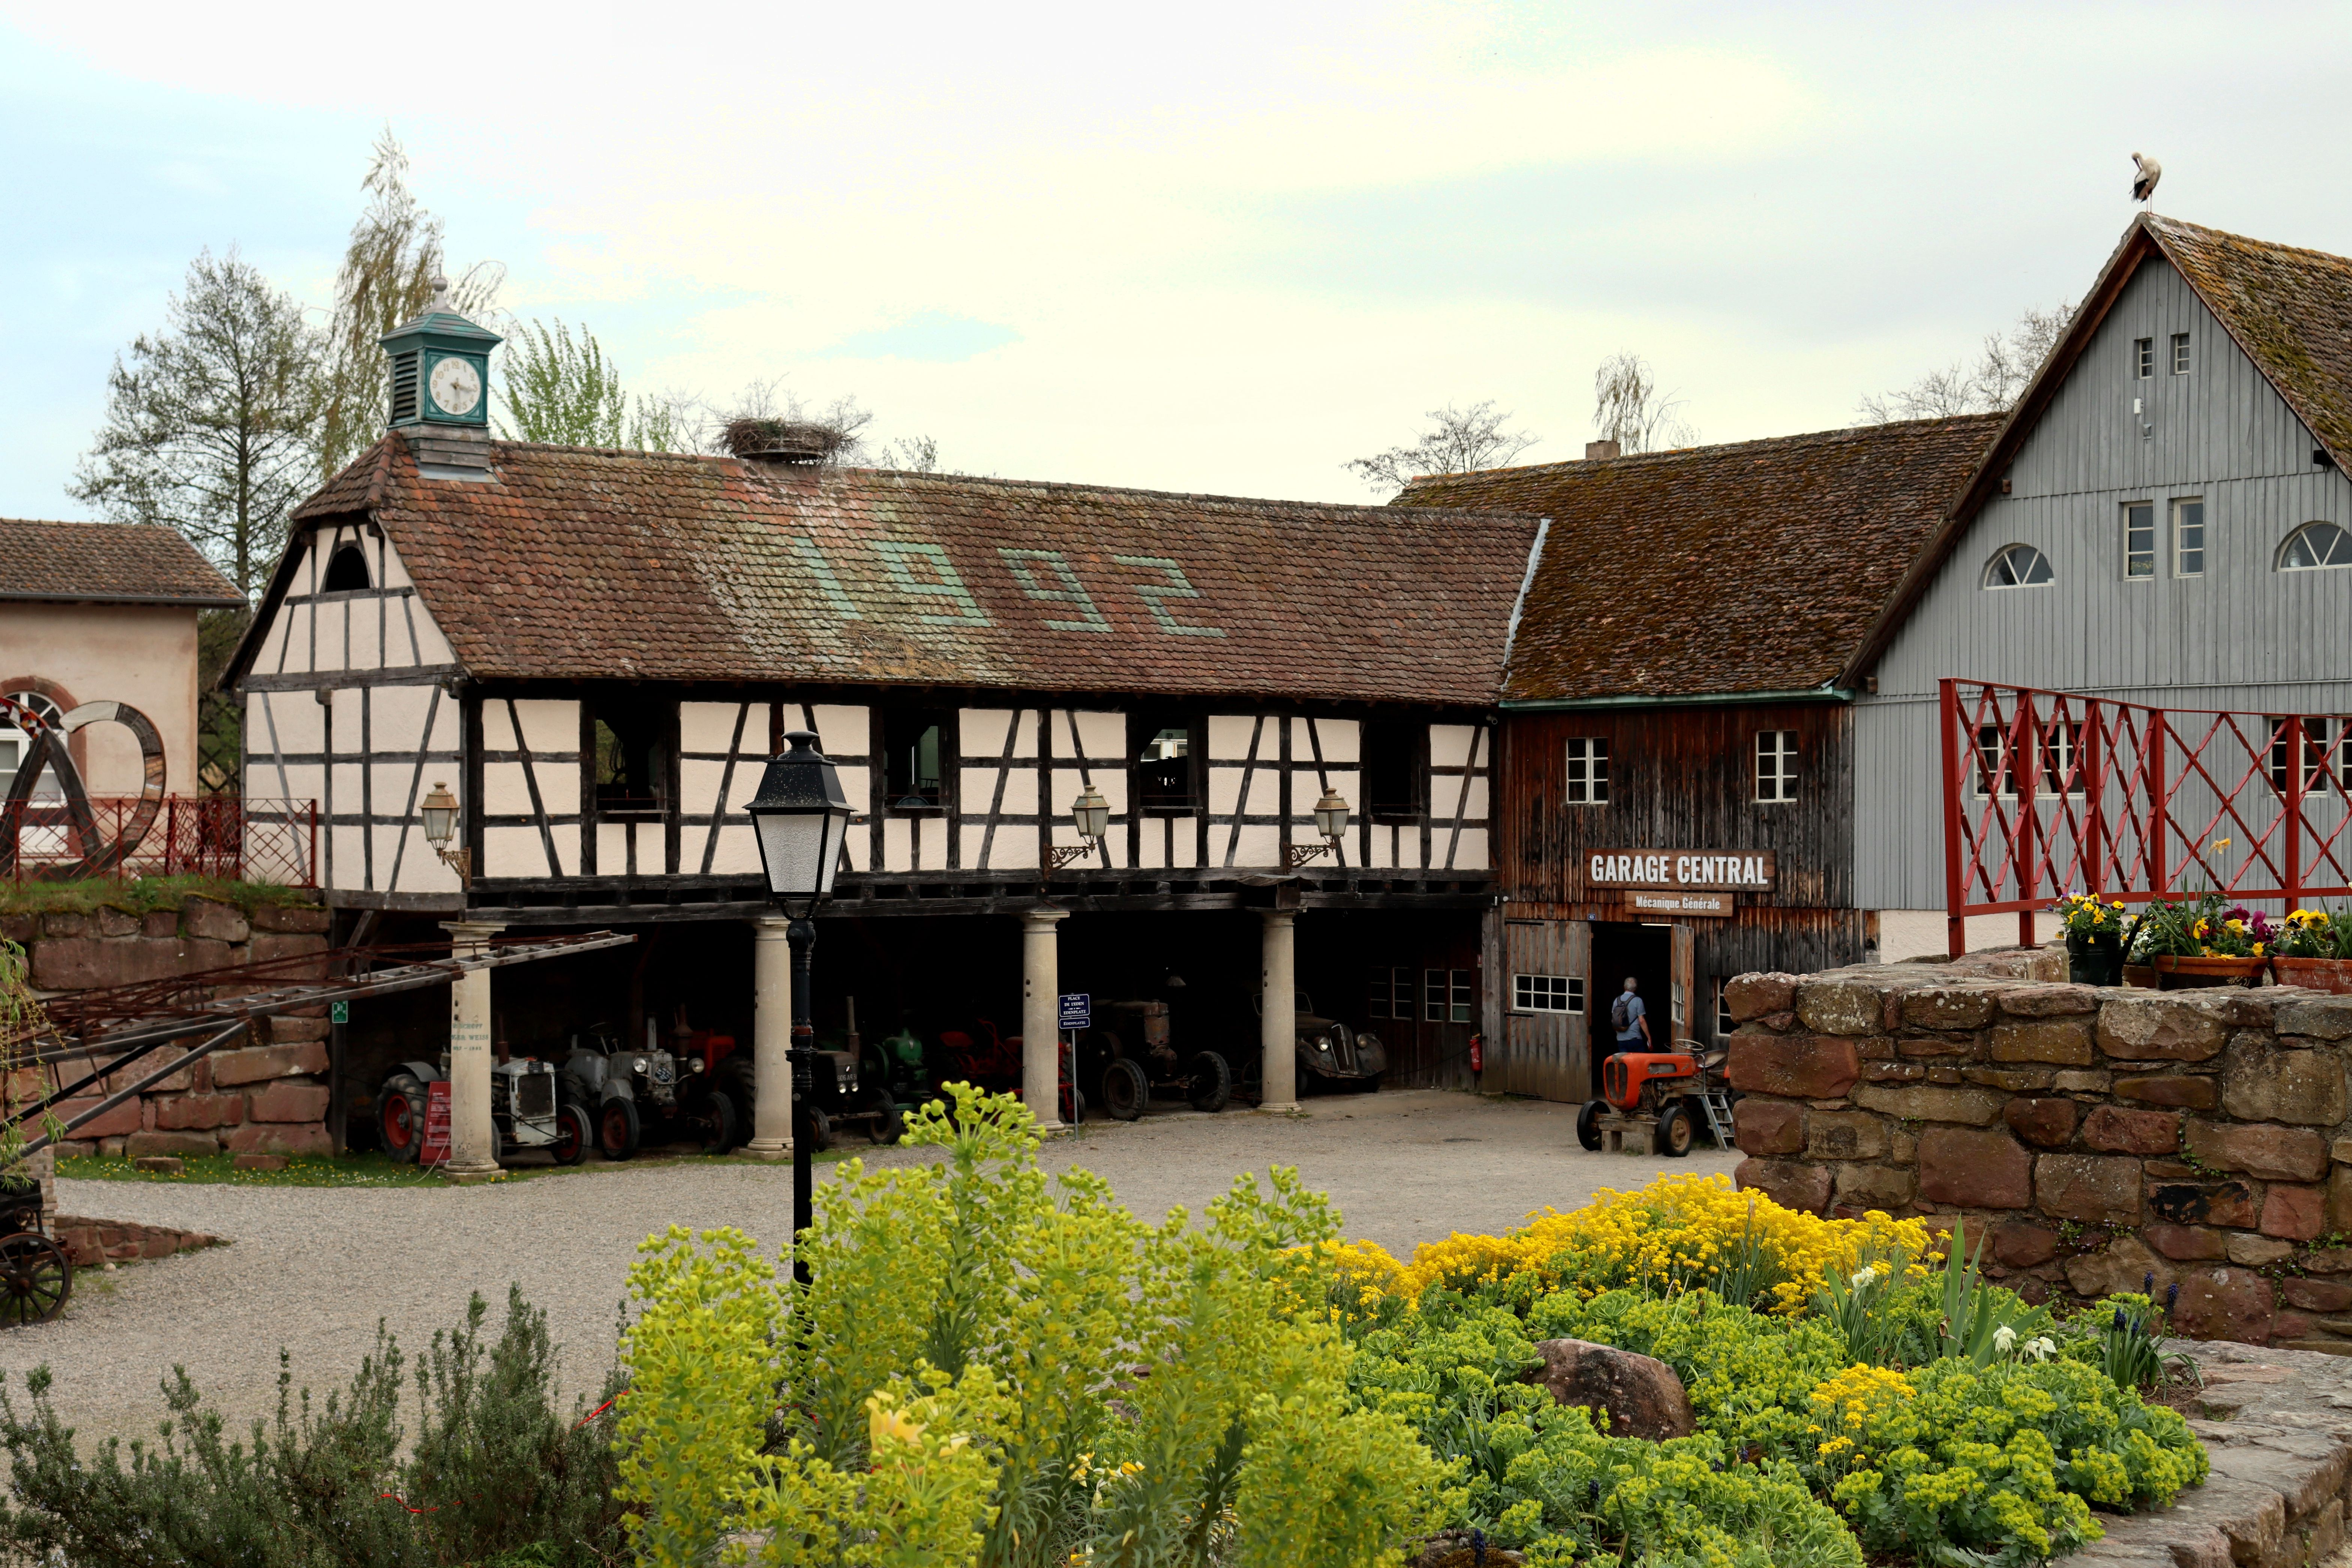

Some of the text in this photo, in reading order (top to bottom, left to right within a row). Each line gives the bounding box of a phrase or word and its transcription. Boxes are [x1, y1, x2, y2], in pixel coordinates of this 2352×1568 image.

[1591, 855, 1768, 884] GARAGE CENTRAL
[1636, 896, 1720, 911] Mécanique Générale
